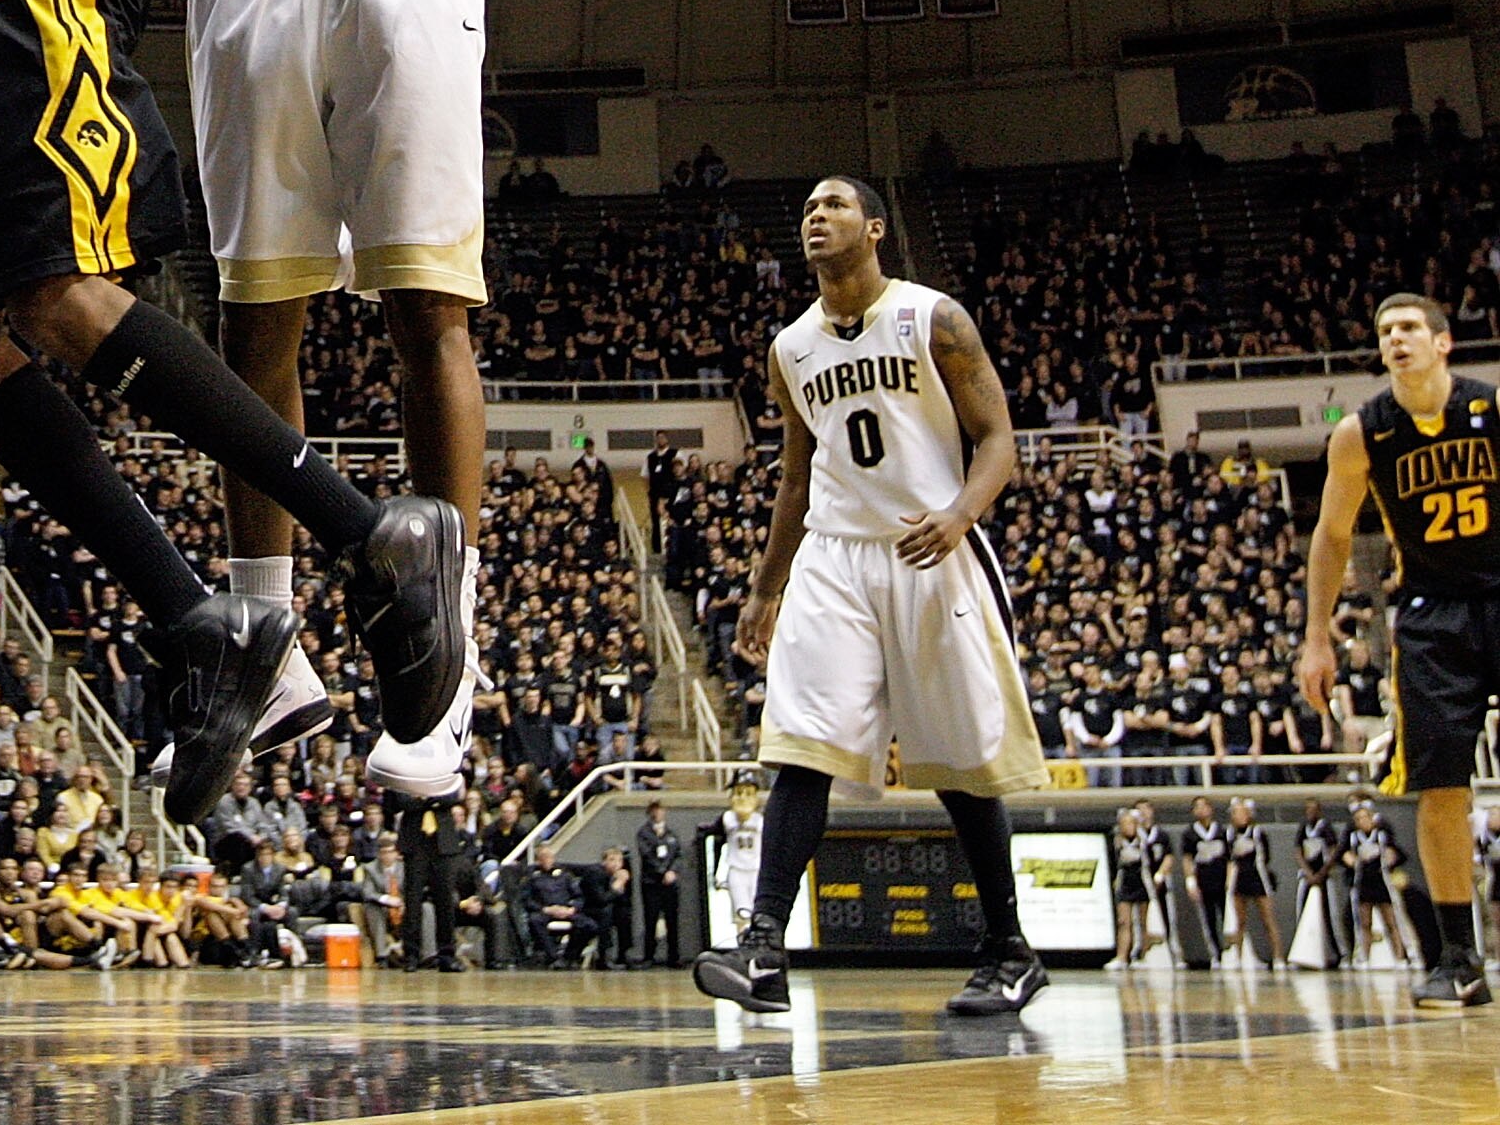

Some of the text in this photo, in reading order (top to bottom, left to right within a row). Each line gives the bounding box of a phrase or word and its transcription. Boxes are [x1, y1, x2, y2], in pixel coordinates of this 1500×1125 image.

[802, 356, 920, 418] PURDUE
[573, 414, 585, 429] 8
[845, 408, 885, 468] 0
[1394, 436, 1498, 501] IOWA
[1422, 485, 1490, 543] 25
